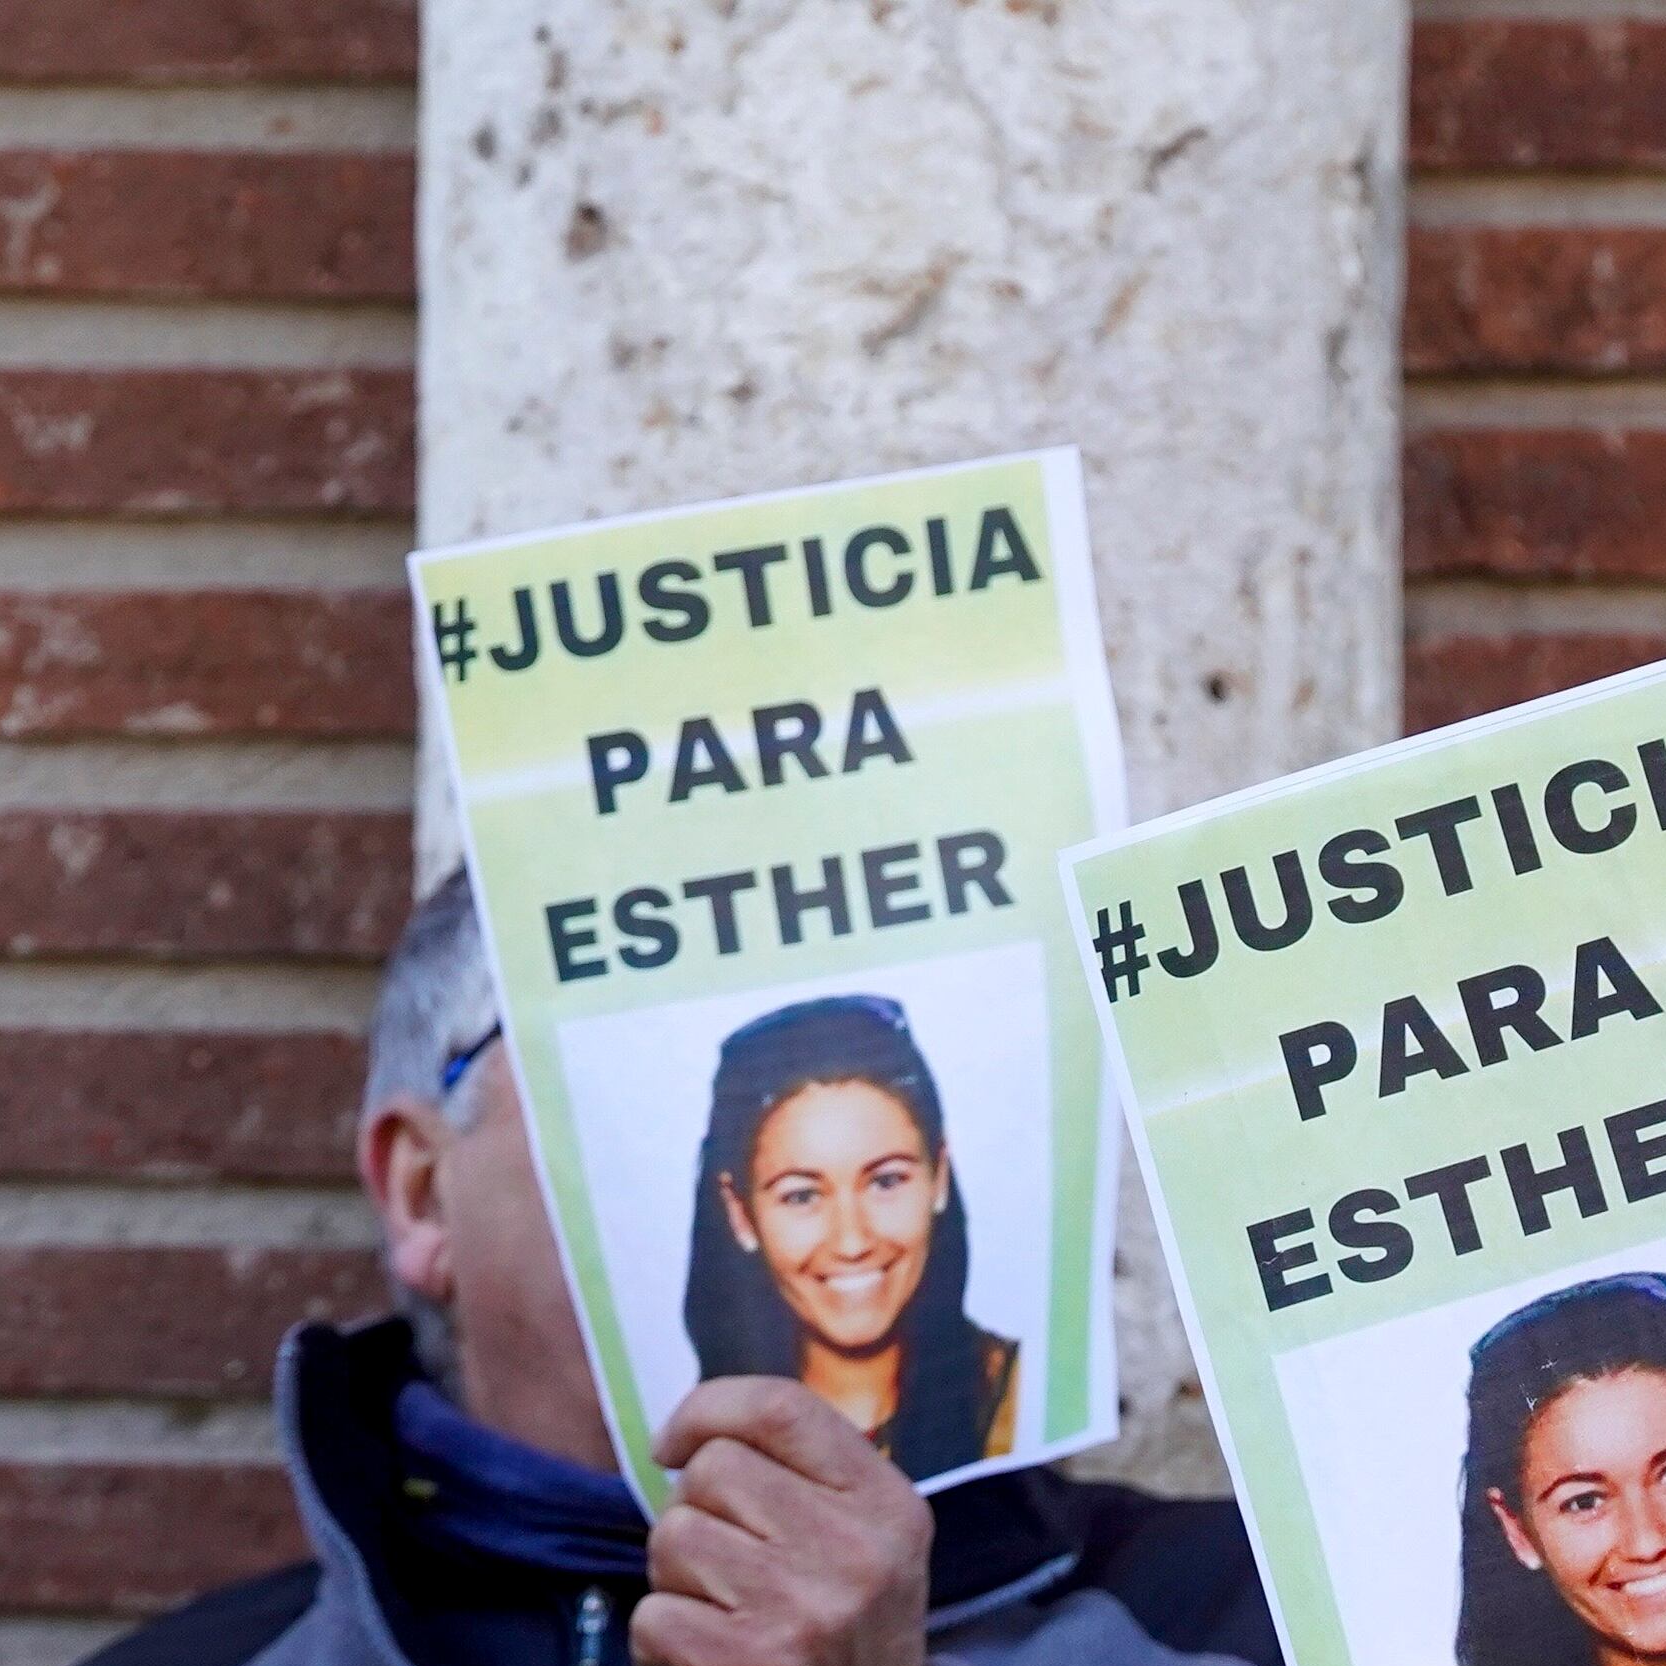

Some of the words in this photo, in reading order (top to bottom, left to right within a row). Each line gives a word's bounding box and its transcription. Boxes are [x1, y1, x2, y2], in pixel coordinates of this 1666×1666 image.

[432, 506, 1043, 683] #JUSTICIA
[586, 688, 914, 816] PARA
[544, 831, 1014, 983] ESTHER
[1278, 935, 1665, 1122] PARA
